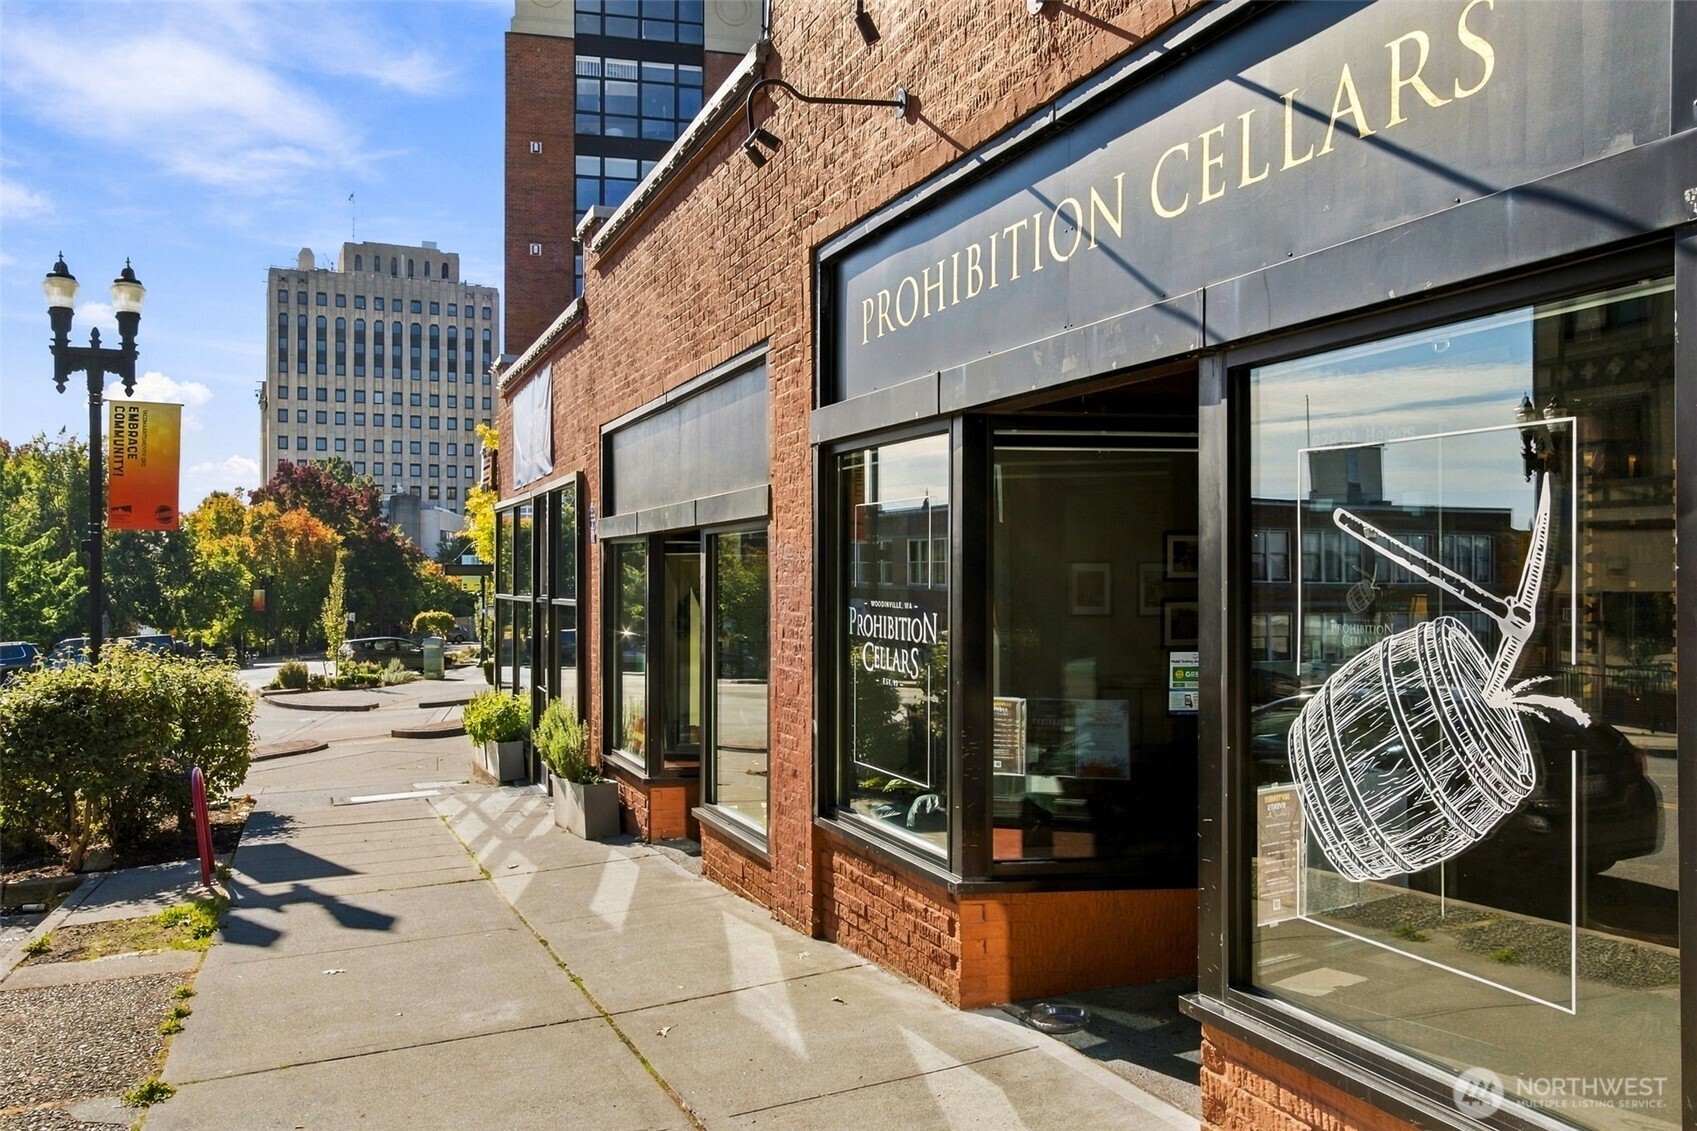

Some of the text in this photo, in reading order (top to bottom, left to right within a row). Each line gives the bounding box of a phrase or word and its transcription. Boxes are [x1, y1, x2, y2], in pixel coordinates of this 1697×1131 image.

[862, 0, 1498, 345] PROHIBITION CELLARS
[113, 406, 125, 476] COMMUNITY!
[127, 406, 139, 460] EMBRACE
[849, 606, 938, 644] PROHIBITION
[1330, 619, 1394, 636] PROHIBITION
[862, 641, 919, 679] CELLARS
